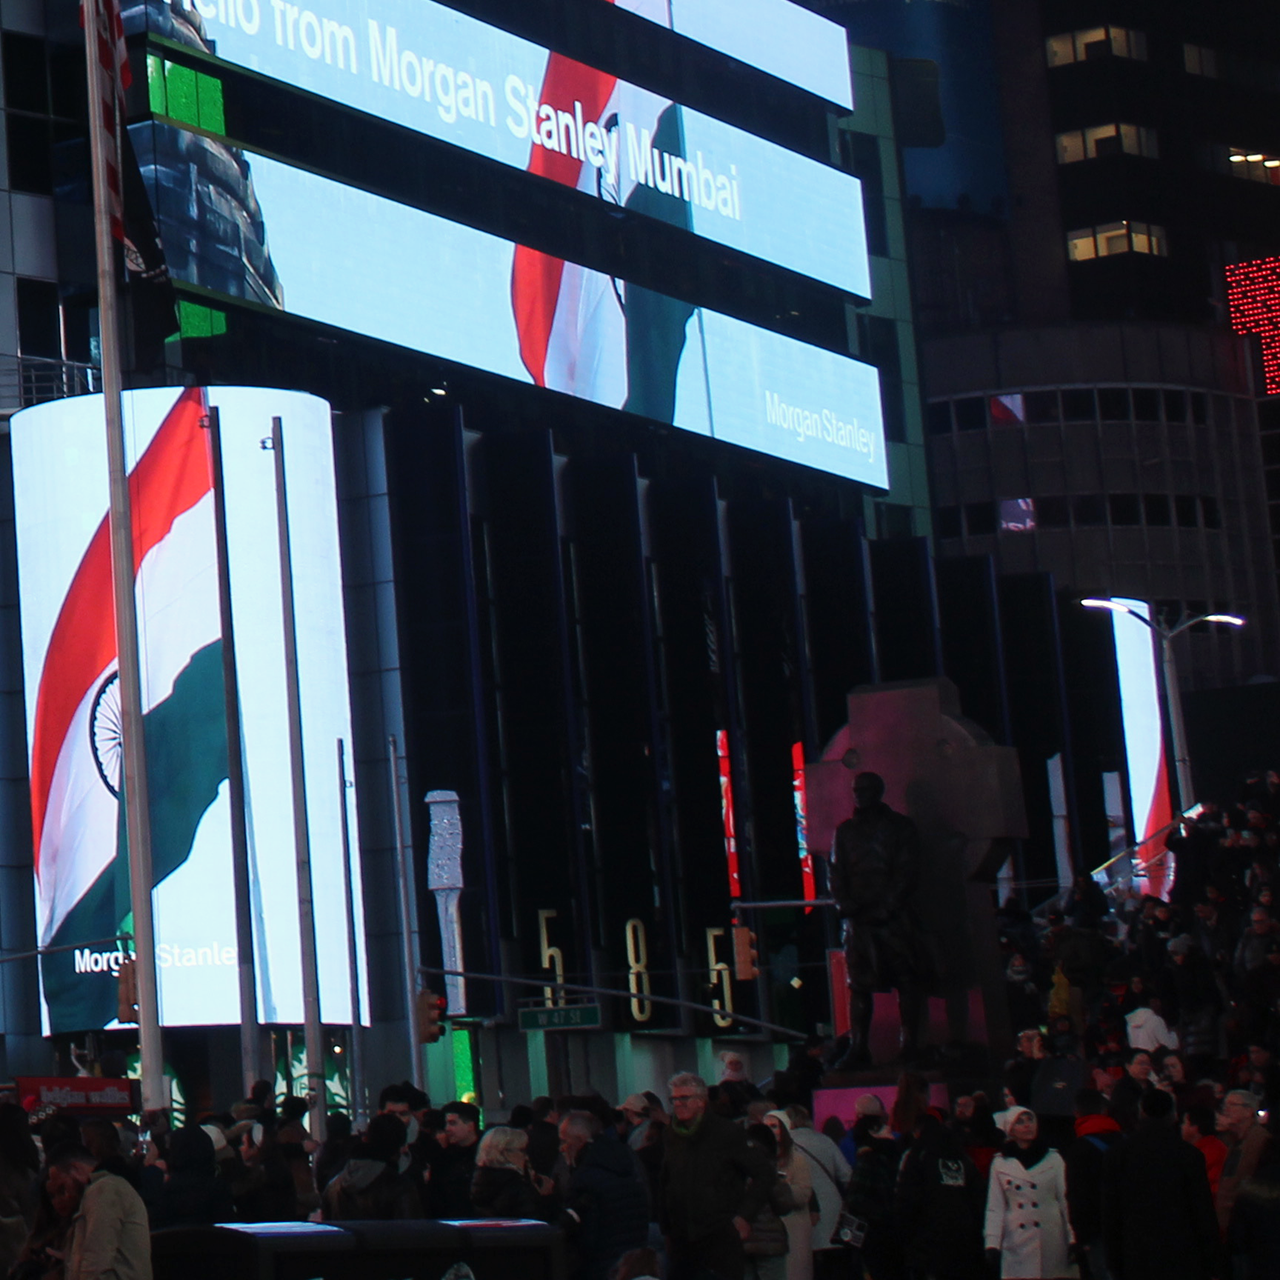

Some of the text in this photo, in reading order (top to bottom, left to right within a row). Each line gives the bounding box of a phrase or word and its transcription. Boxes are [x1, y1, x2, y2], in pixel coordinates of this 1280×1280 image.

[367, 20, 496, 139] Morgan
[505, 73, 619, 186] Stanley
[625, 121, 741, 221] Mumbai
